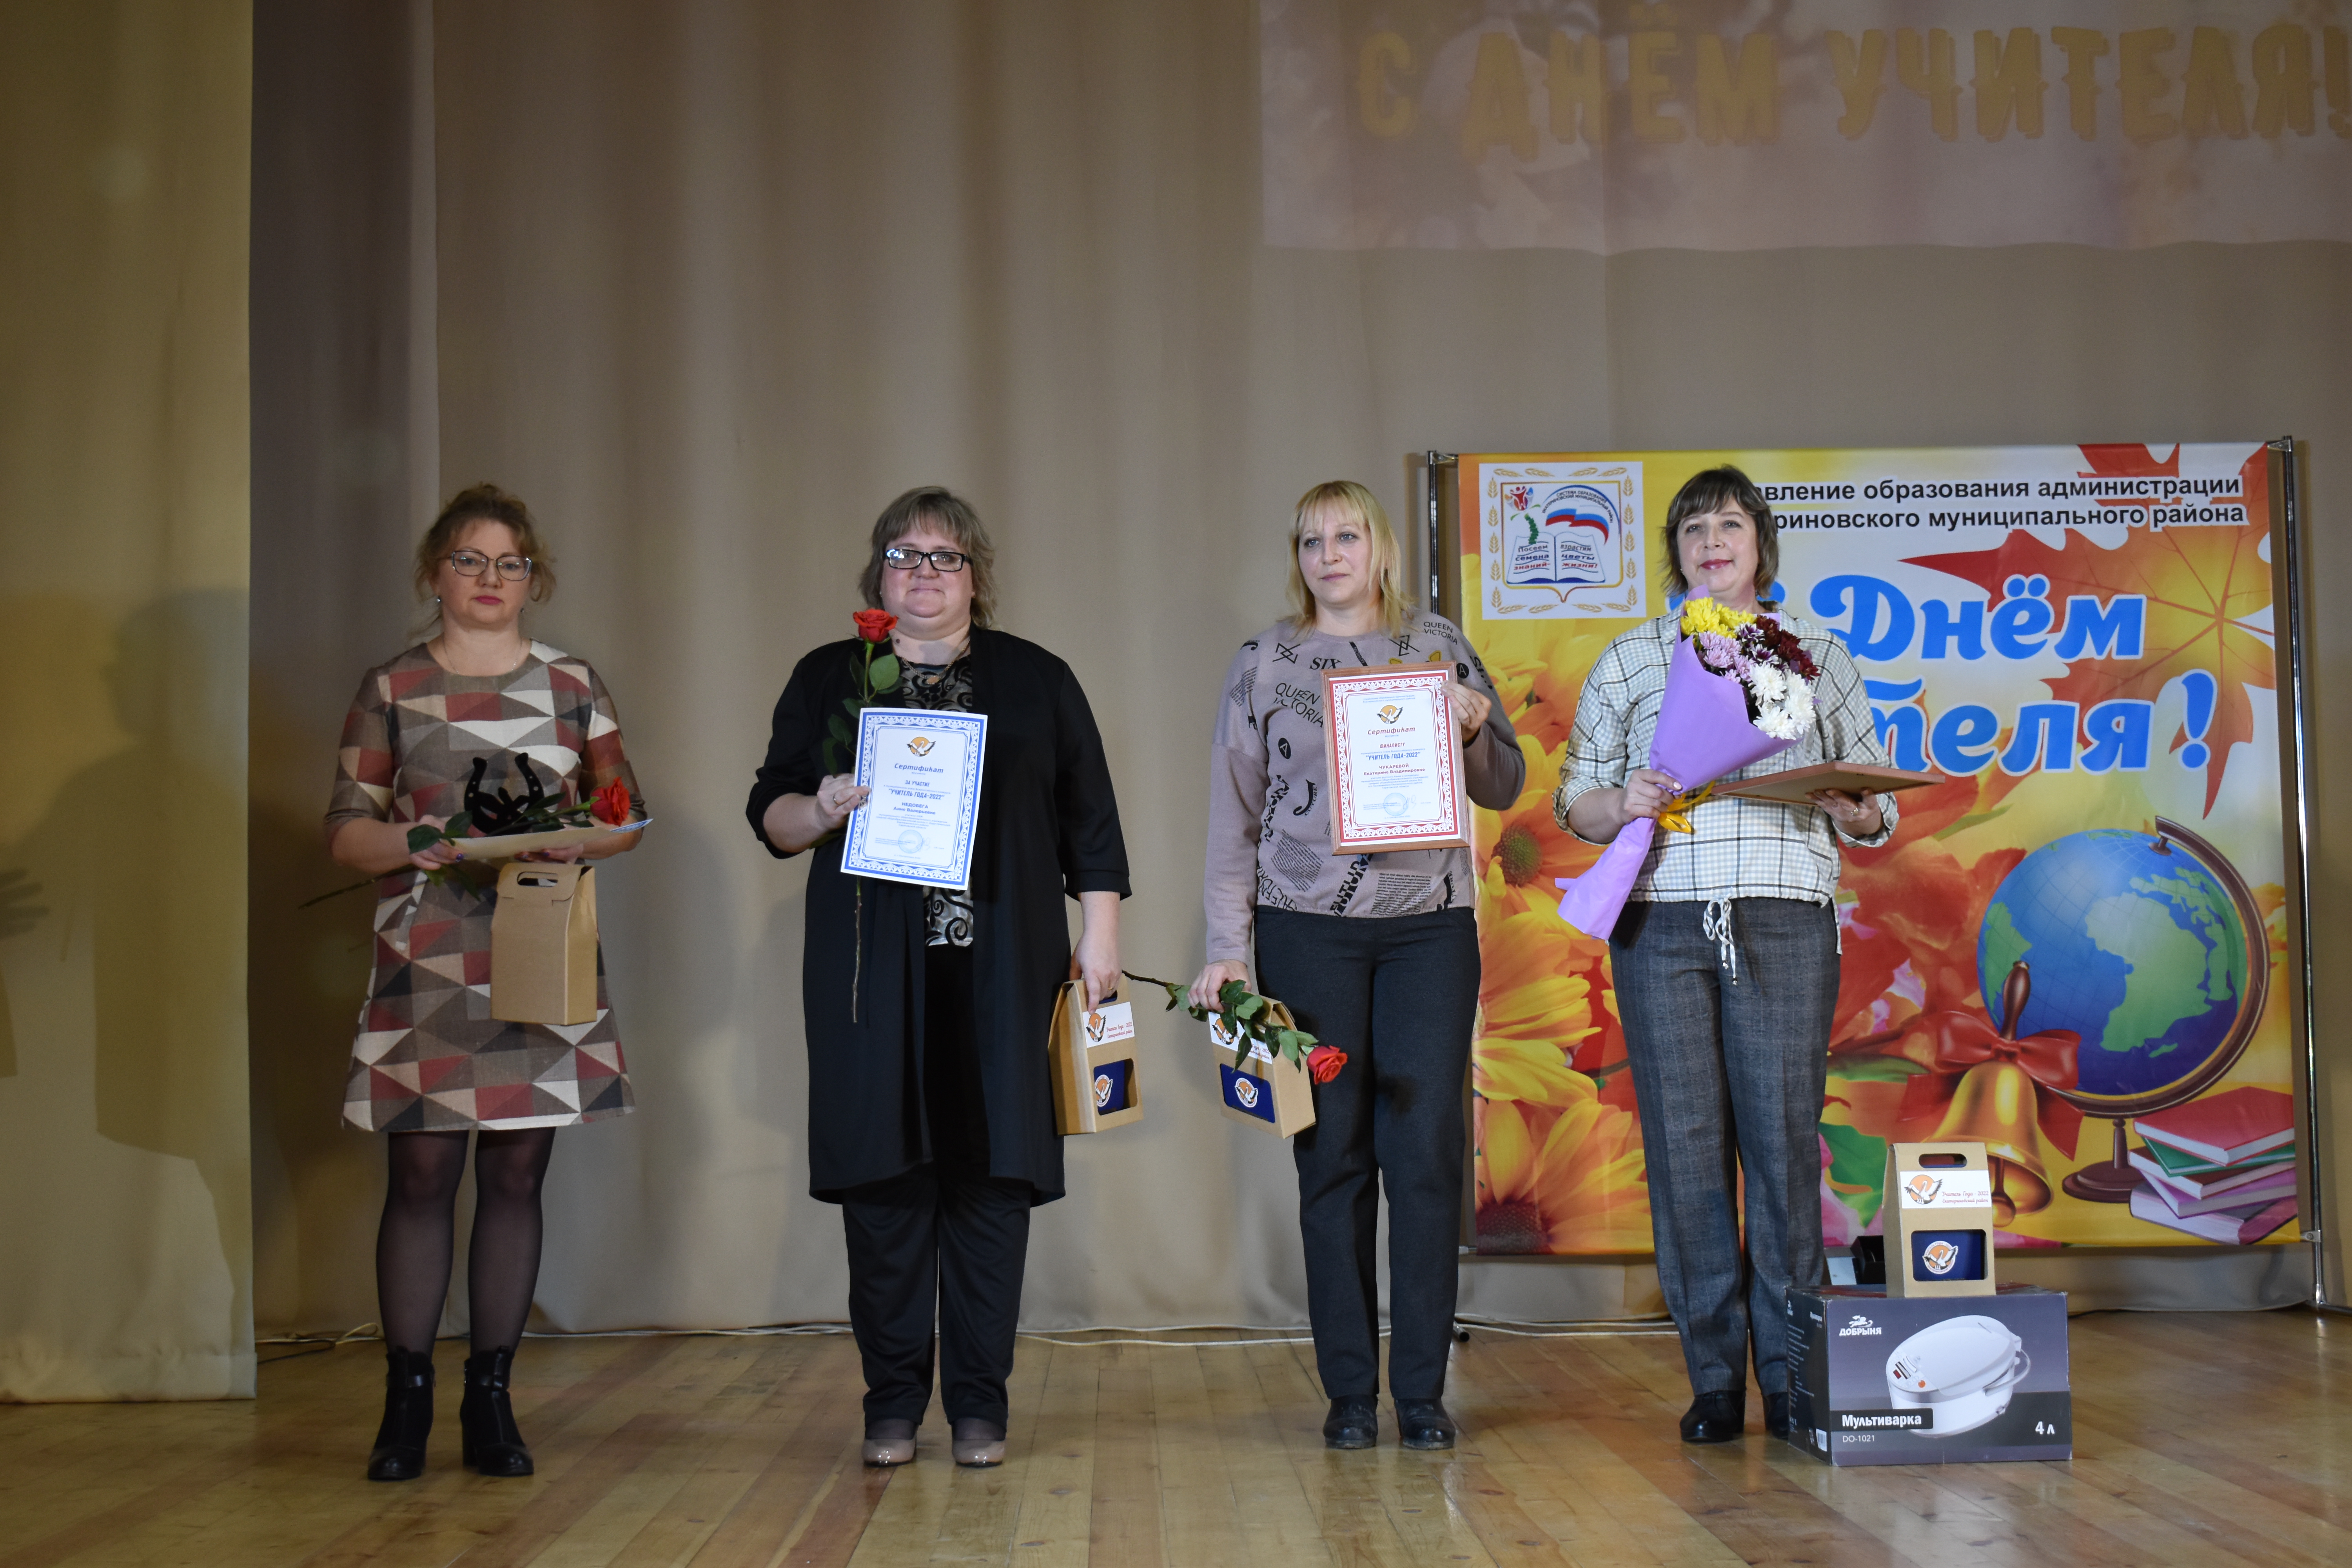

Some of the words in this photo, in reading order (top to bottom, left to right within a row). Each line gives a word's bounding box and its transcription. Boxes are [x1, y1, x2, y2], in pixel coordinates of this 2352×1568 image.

[1356, 31, 1417, 140] С
[1460, 4, 1783, 163] ДНЁМ
[1824, 24, 2352, 142] УЧИТЕЛЯ!
[1577, 490, 1607, 503] ОБРАЗОВАНИЯ
[1757, 485, 1855, 501] вление
[1864, 479, 2029, 503] образования
[2038, 478, 2239, 499] администрации
[1929, 509, 2144, 532] муниципального
[2154, 503, 2243, 528] района
[1810, 575, 2145, 661] Днём
[1423, 621, 1453, 633] QUEEN
[1424, 628, 1458, 645] VICTORIA
[1309, 657, 1342, 670] SIX
[1368, 727, 1415, 735] Сертификат
[894, 763, 944, 773] Сертификат
[1838, 1327, 1882, 1336] ДОБРЫНЯ
[1842, 1414, 1922, 1429] Мультиварка
[2035, 1422, 2044, 1435] 4
